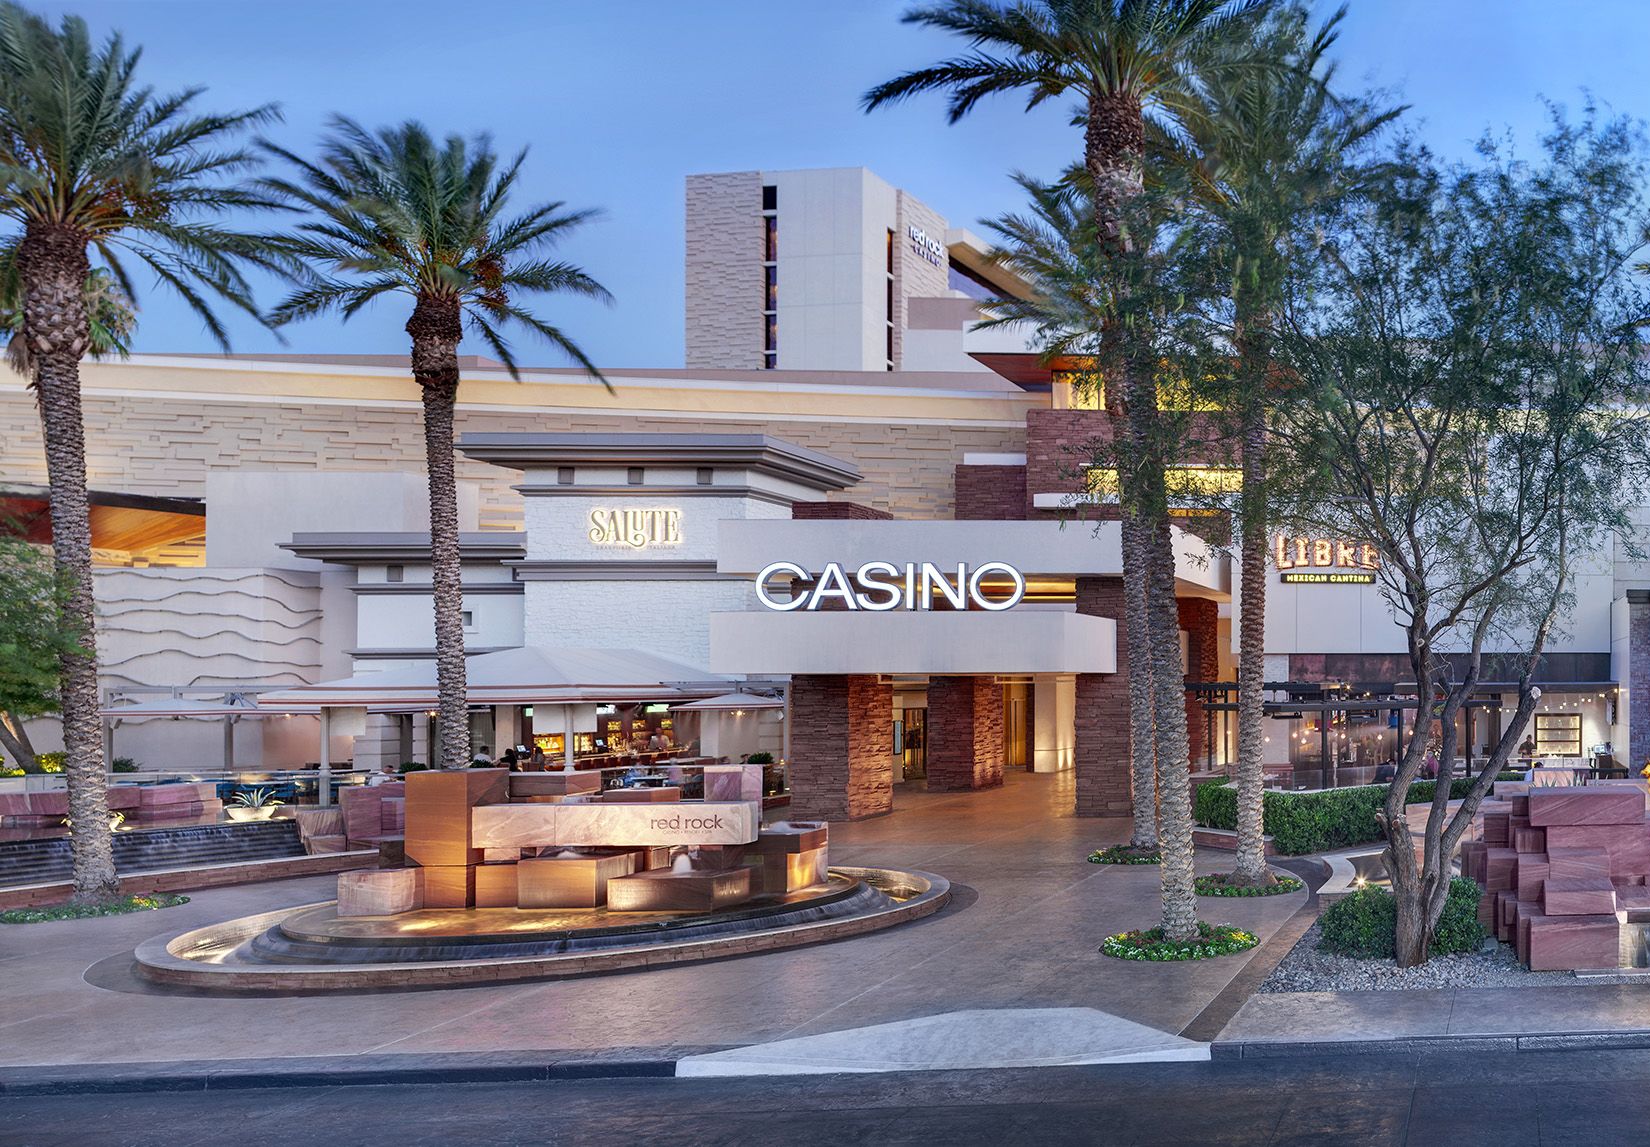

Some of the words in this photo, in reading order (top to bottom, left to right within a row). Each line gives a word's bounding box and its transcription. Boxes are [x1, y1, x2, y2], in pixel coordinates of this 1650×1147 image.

[908, 225, 925, 246] red
[925, 236, 945, 258] rock
[589, 509, 679, 547] SALUTE
[1275, 532, 1381, 571] LIBRE
[755, 561, 1026, 611] CASINO
[1286, 574, 1327, 583] MEXICAN
[1330, 574, 1371, 583] CANTINA
[650, 814, 680, 830] red
[684, 814, 724, 829] rock
